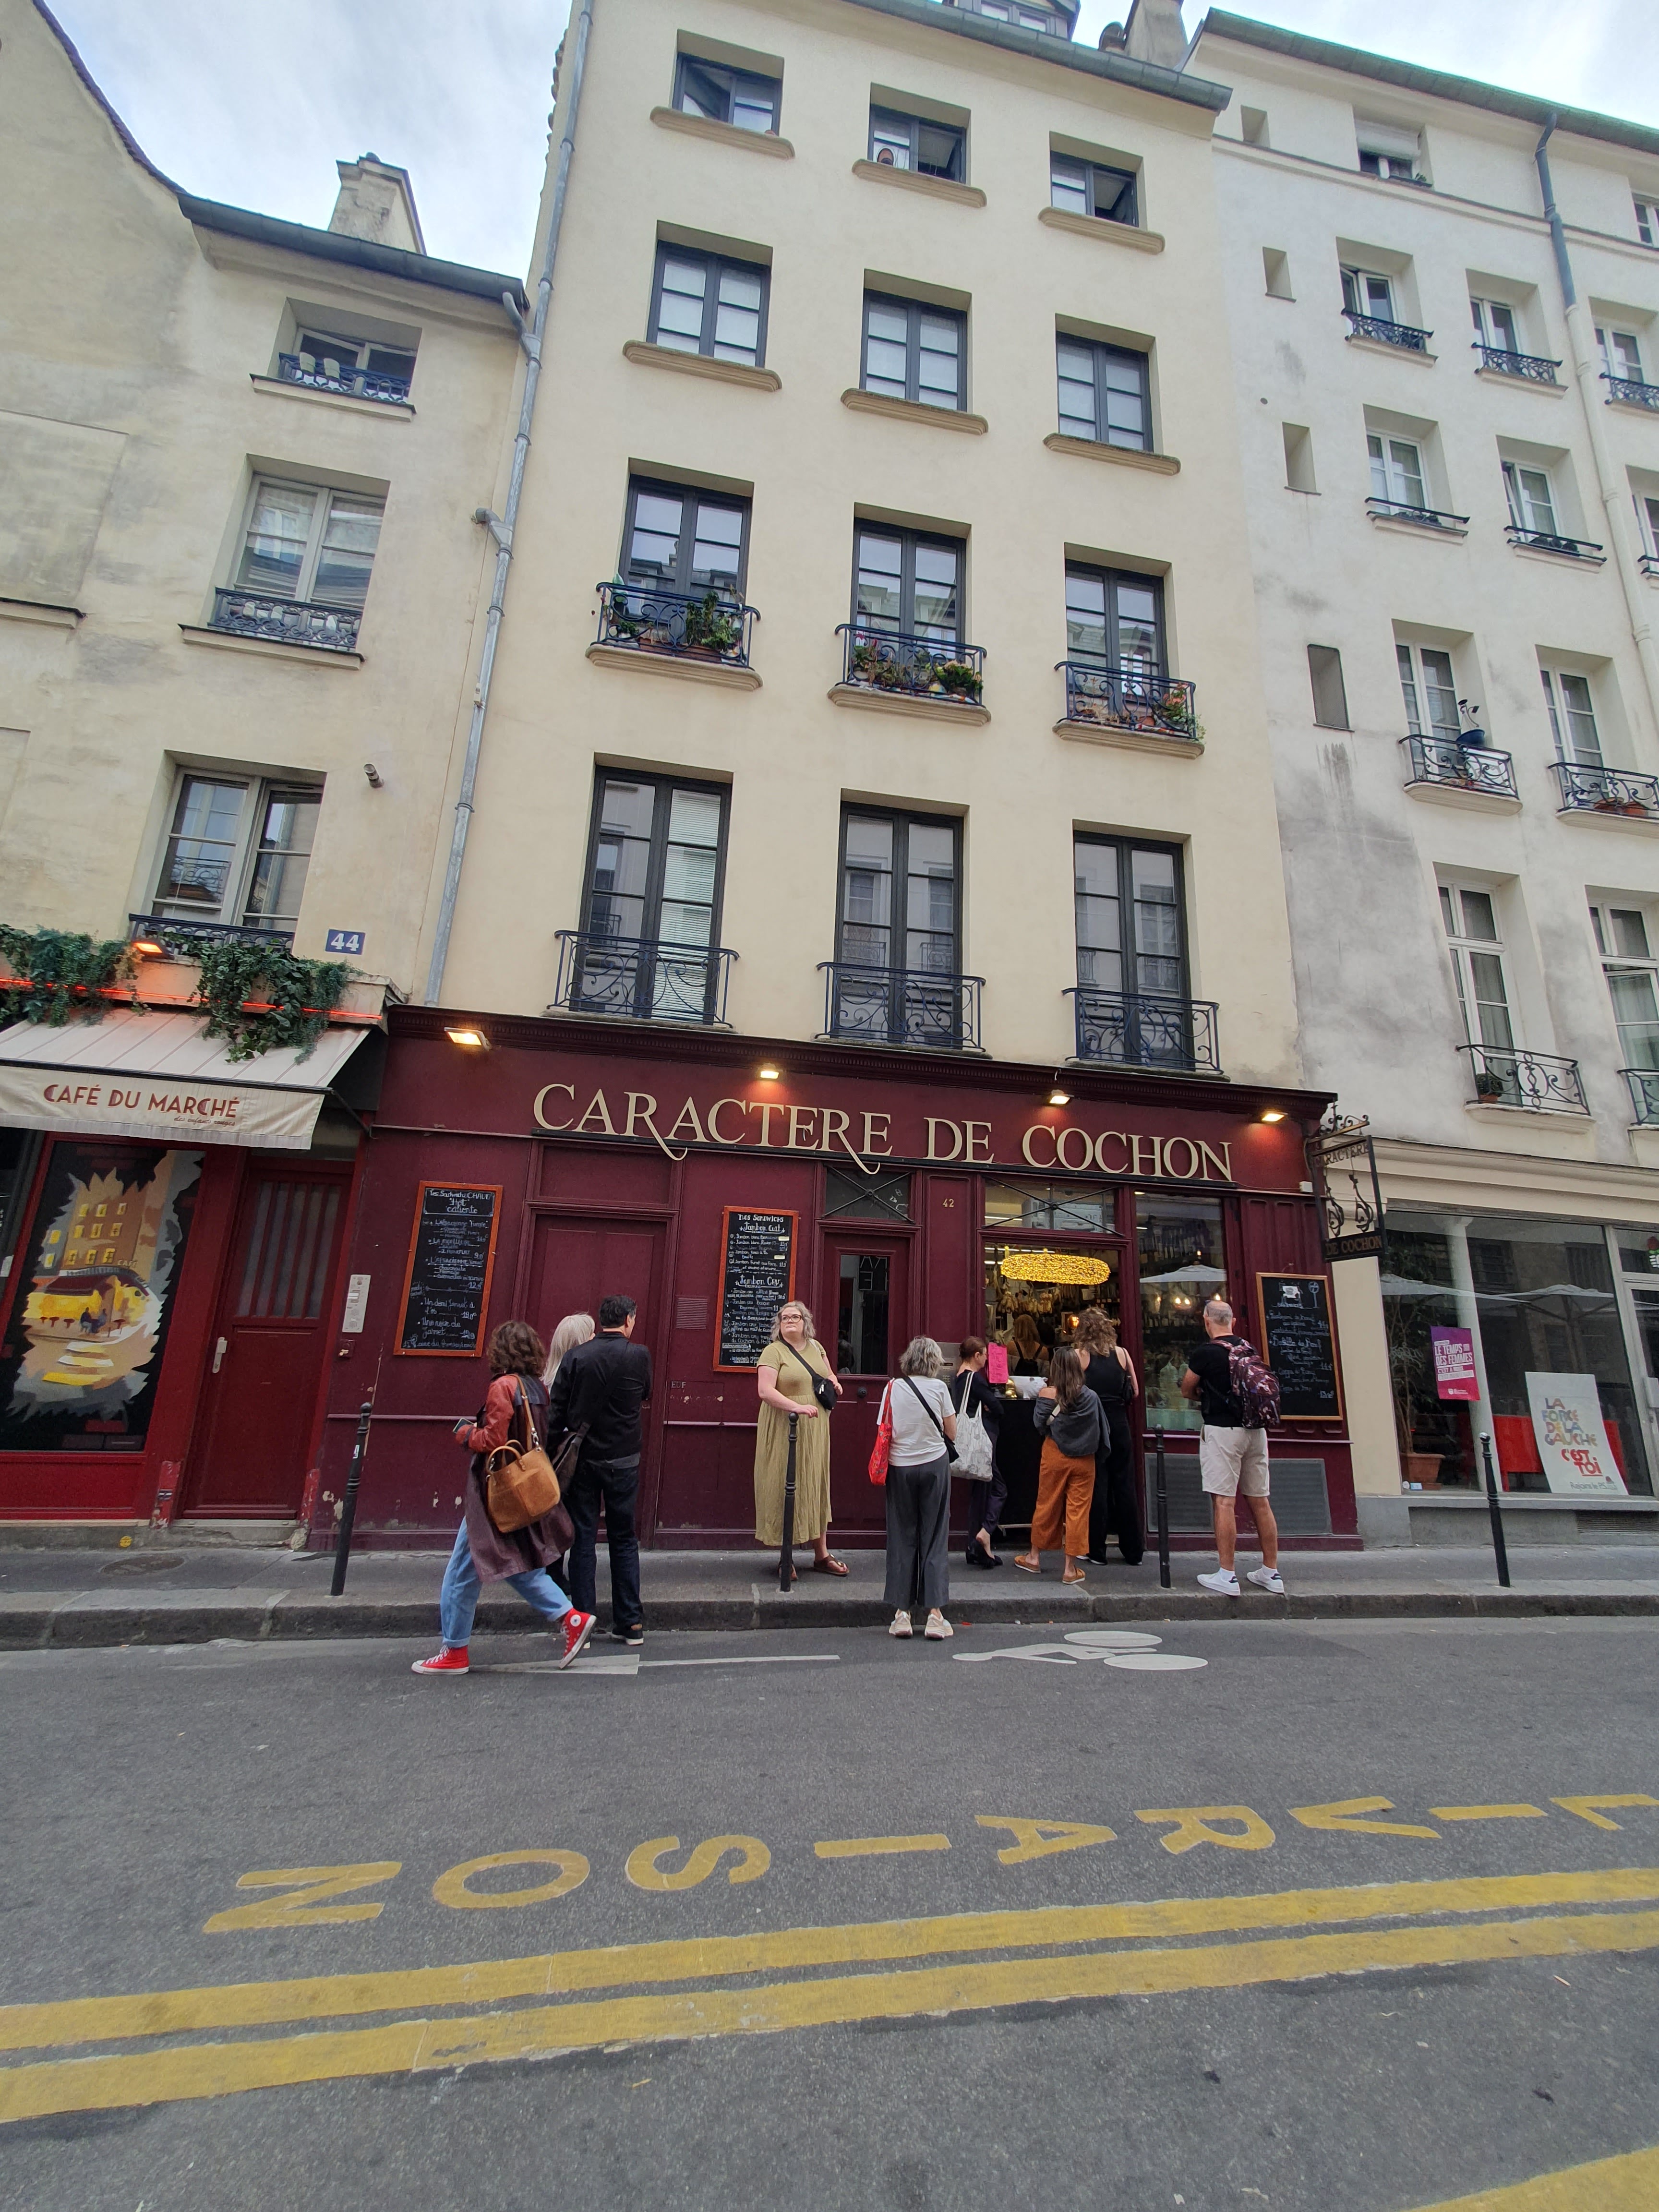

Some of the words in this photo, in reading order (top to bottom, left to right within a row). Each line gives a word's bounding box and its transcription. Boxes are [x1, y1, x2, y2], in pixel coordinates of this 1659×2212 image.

[330, 933, 360, 951] 44
[43, 1084, 102, 1106] CAFÉ
[108, 1089, 142, 1109] DU
[148, 1092, 241, 1118] MARCHÉ
[533, 1083, 893, 1175] CARACTERE
[923, 1117, 994, 1164] DE
[1022, 1124, 1232, 1182] COCHON
[942, 1198, 954, 1208] 42
[1325, 1242, 1338, 1255] DE
[1341, 1235, 1382, 1253] COCHON
[1434, 1346, 1442, 1356] LE
[1443, 1343, 1462, 1355] TEMPS
[1436, 1355, 1447, 1366] DES
[1448, 1352, 1473, 1365] FEMMES
[1545, 1397, 1565, 1409] LA
[1541, 1409, 1579, 1422] FORCE
[1546, 1421, 1563, 1433] DE
[1563, 1422, 1584, 1433] LA
[1544, 1433, 1598, 1447] GAUCHE
[1561, 1448, 1590, 1462] C'EST
